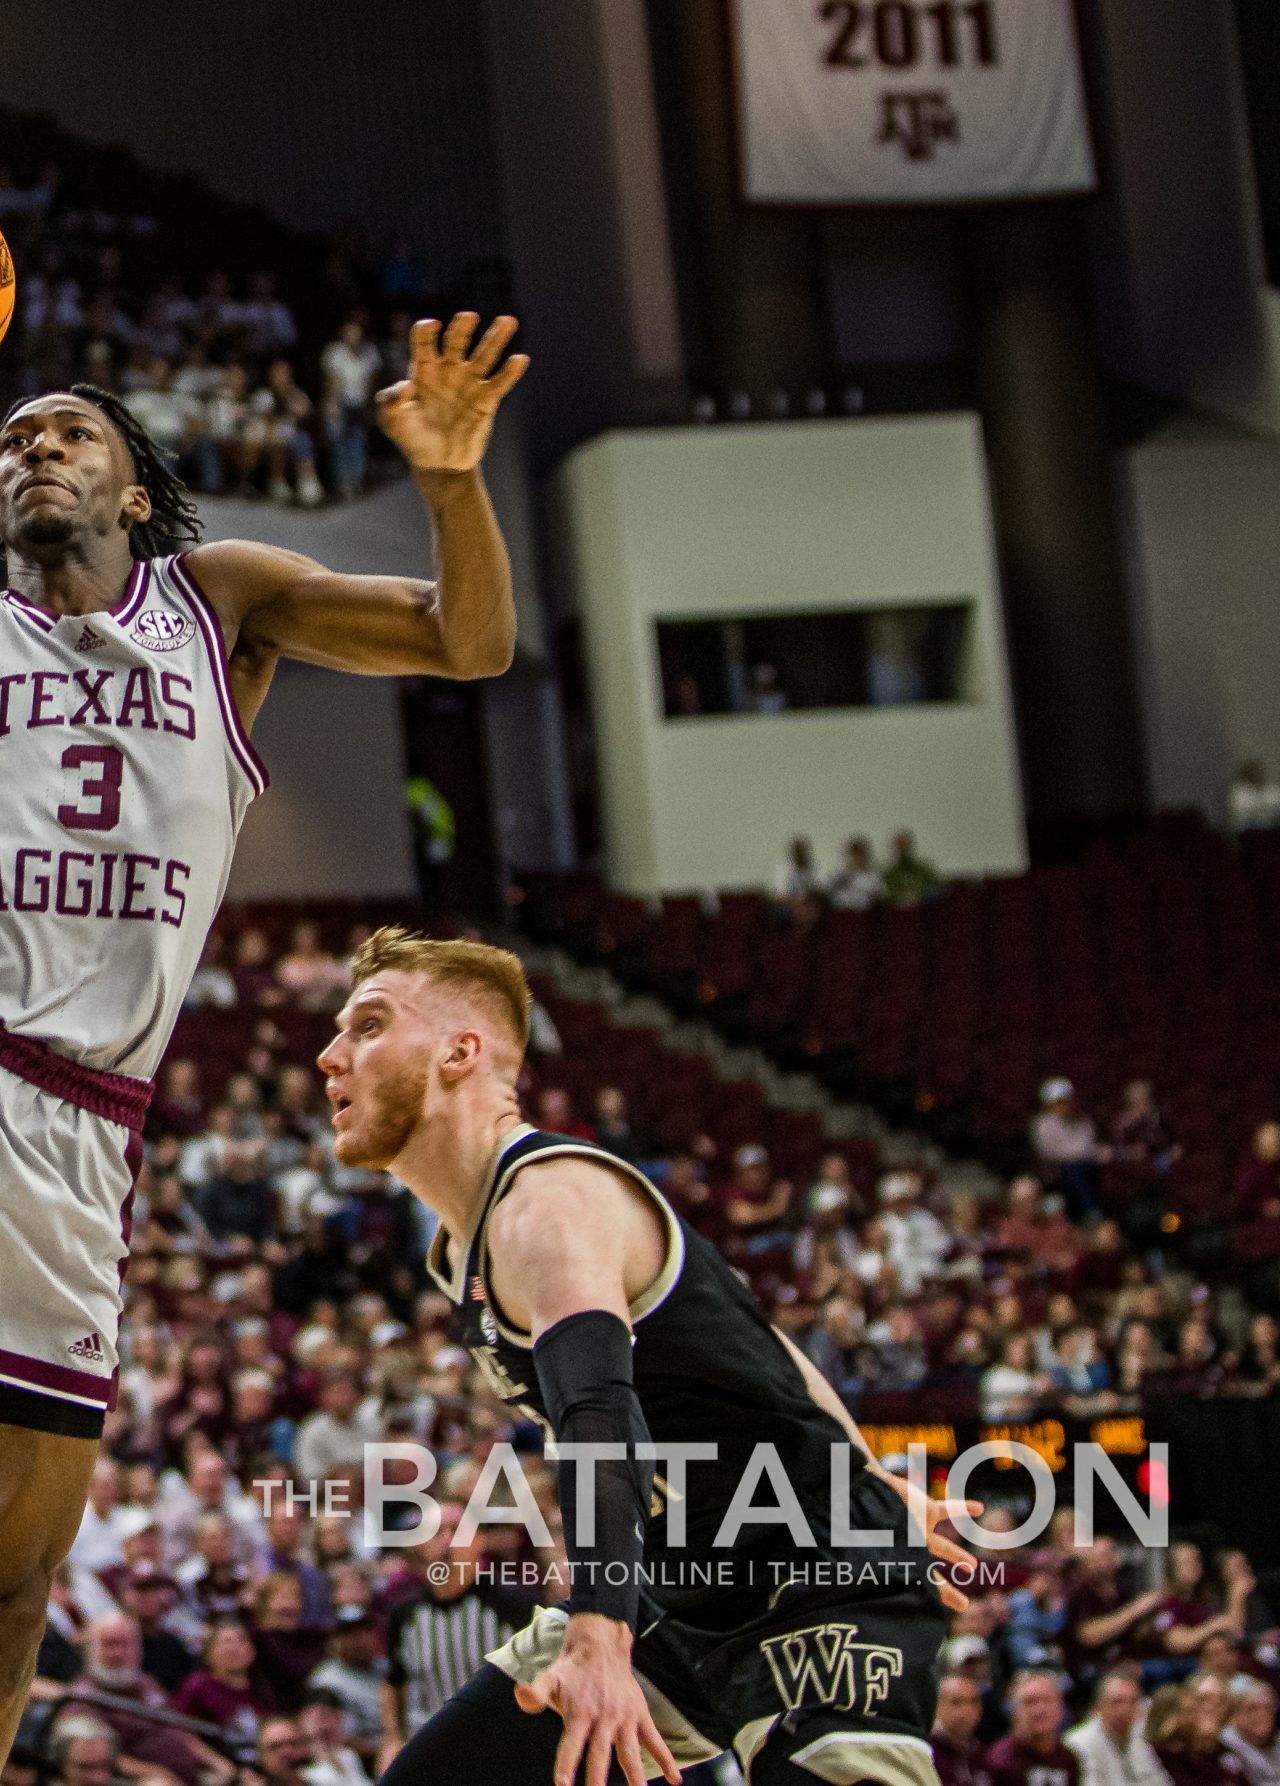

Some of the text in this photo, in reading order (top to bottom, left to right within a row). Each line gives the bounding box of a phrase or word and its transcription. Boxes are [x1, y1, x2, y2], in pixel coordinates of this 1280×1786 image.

[817, 0, 997, 69] 2011
[139, 609, 184, 640] SEC
[57, 744, 124, 832] 3
[67, 1345, 104, 1362] adidas
[759, 1622, 904, 1718] WF
